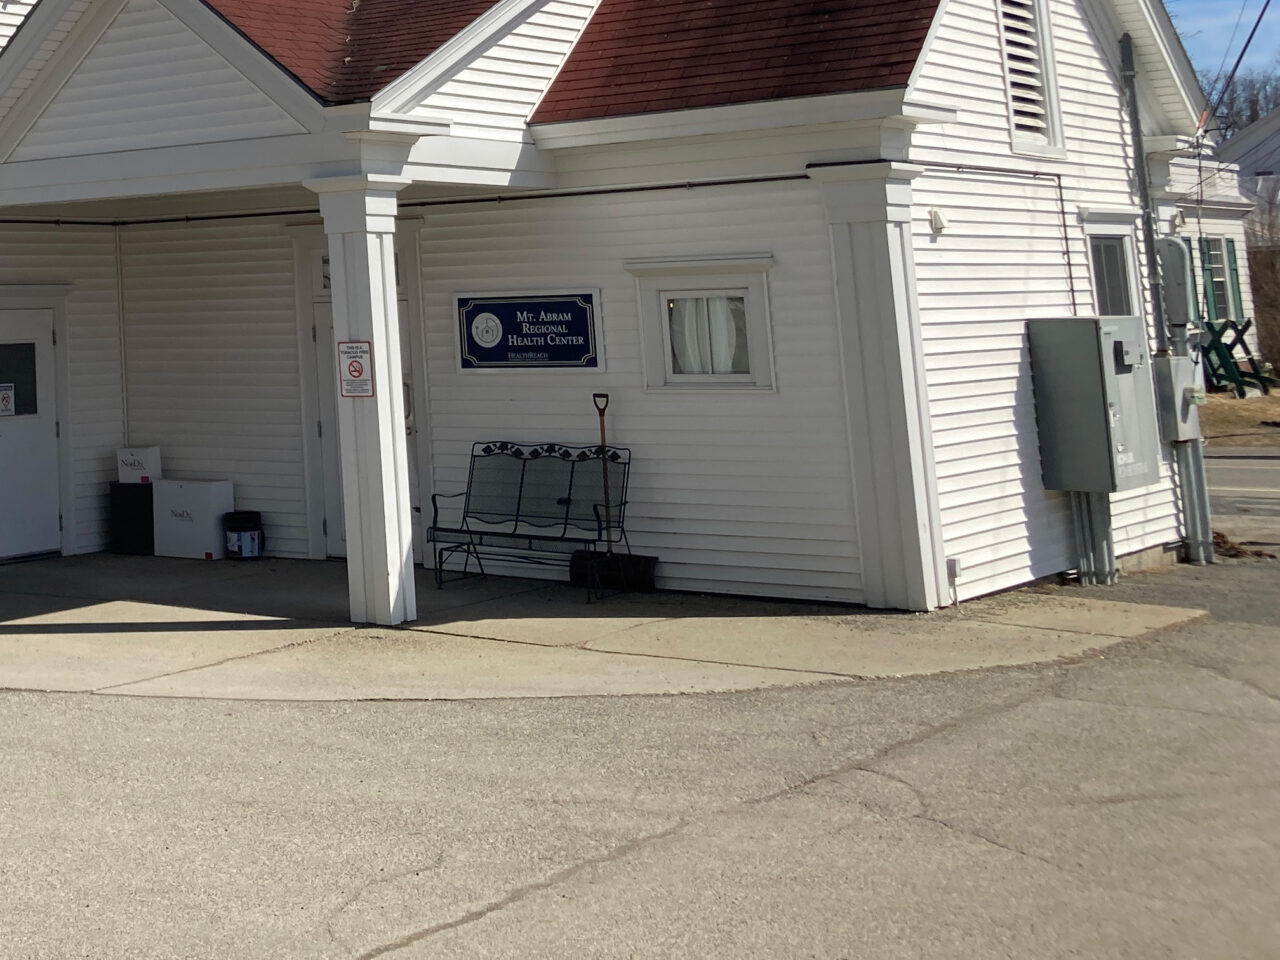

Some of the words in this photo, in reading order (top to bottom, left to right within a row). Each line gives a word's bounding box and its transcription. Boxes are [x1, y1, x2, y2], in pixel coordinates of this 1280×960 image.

[539, 310, 572, 321] ABRAM
[522, 322, 568, 334] REGIONAL
[508, 334, 544, 346] HEALTH
[547, 334, 584, 345] CENTER
